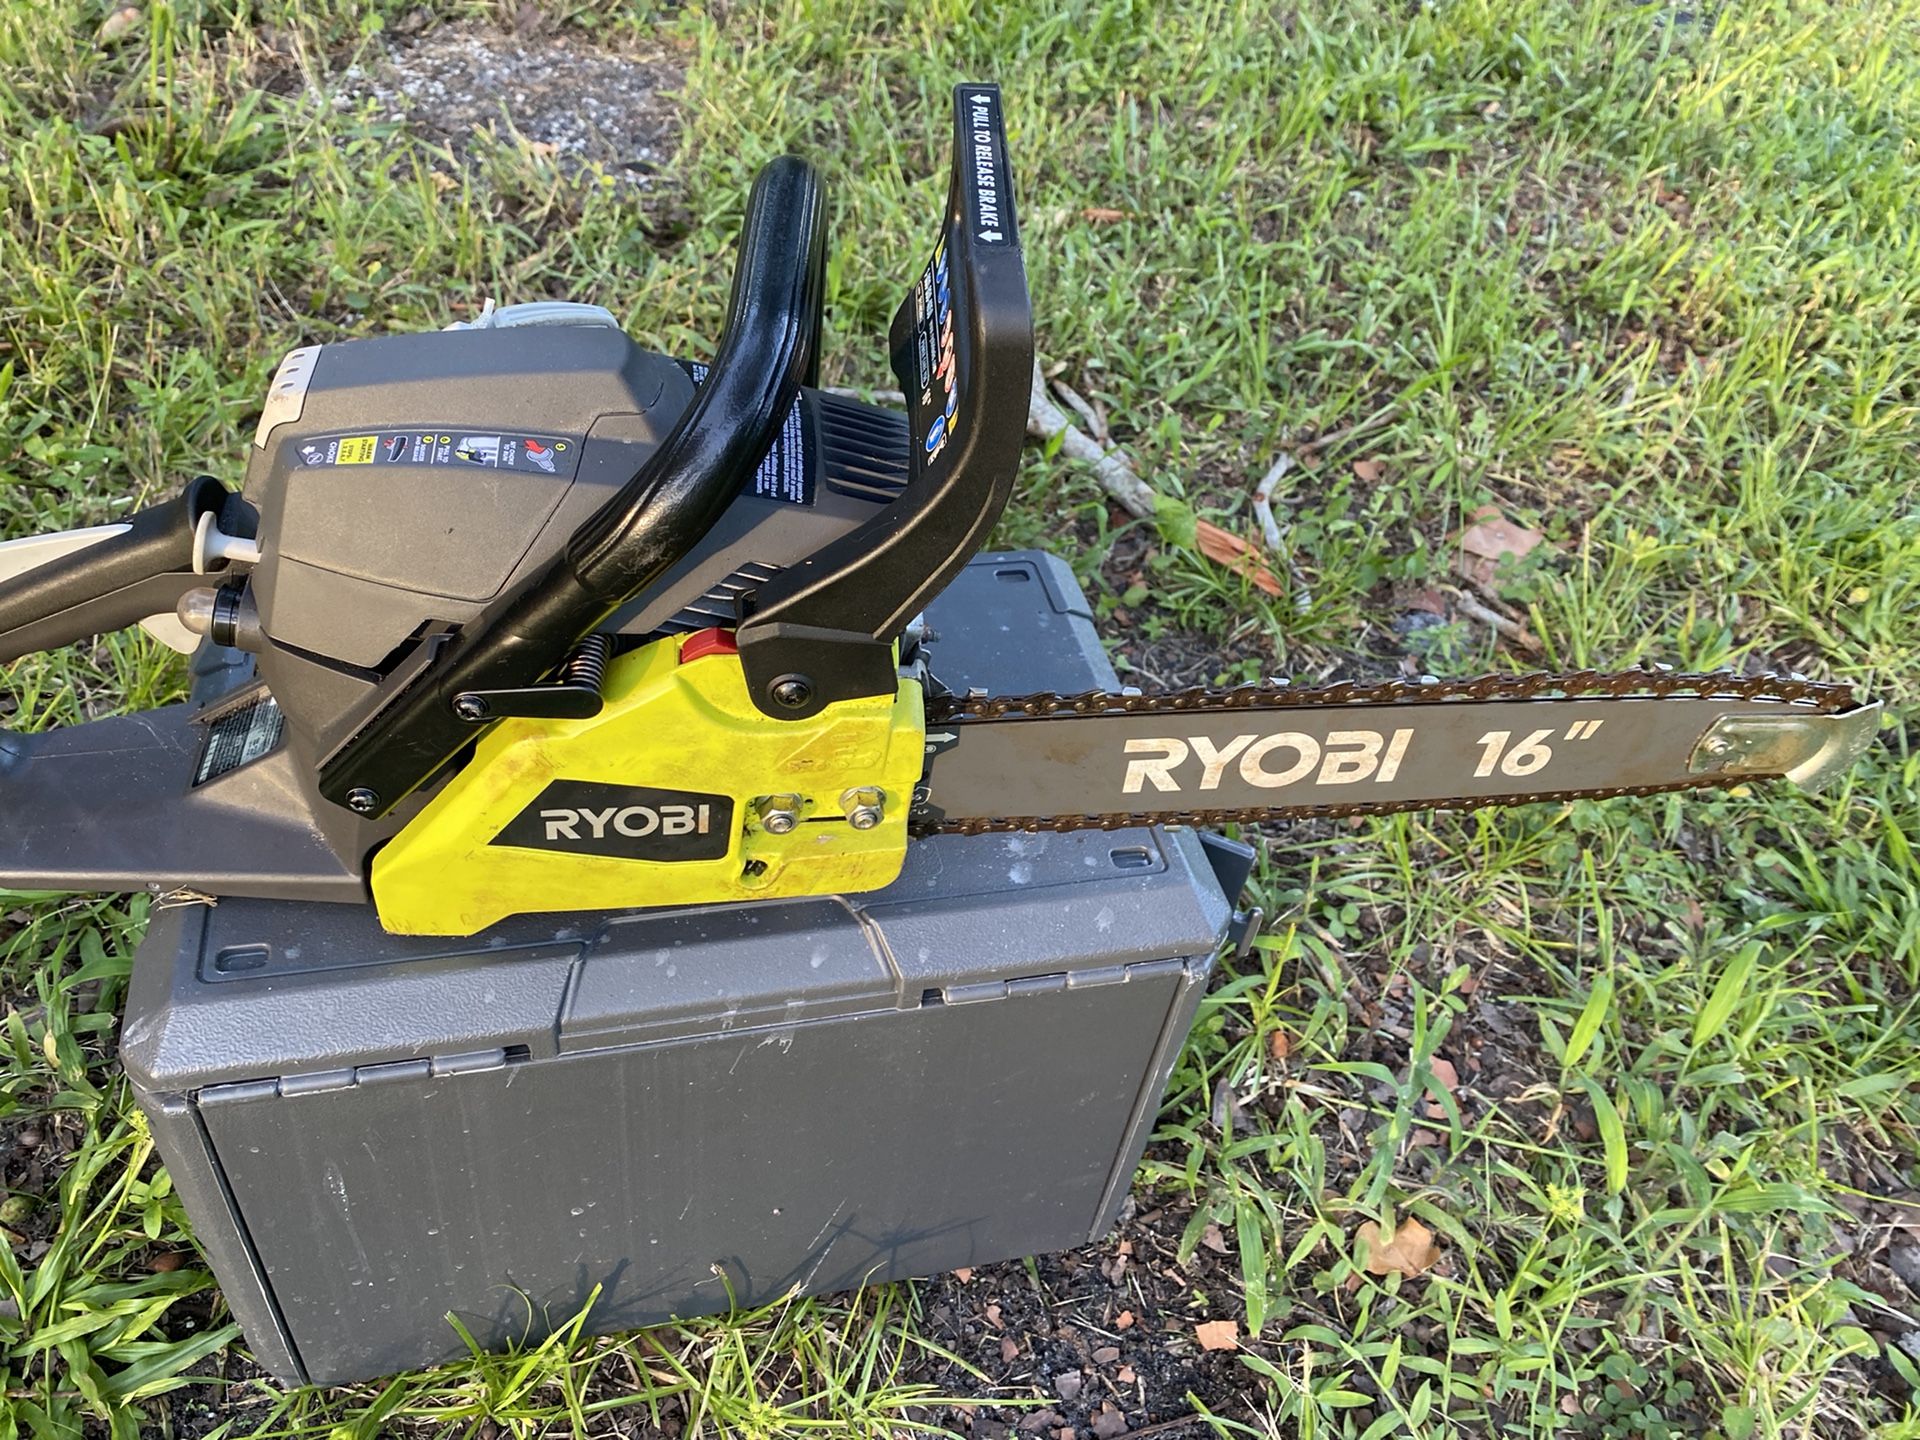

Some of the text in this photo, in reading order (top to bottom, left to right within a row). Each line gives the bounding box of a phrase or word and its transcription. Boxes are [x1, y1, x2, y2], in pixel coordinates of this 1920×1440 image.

[972, 106, 999, 227] PULL TO RELEASE BRAKE
[326, 442, 338, 464] CHOKE
[1122, 720, 1604, 794] RYOBI 16"
[540, 804, 710, 840] RYOBI
